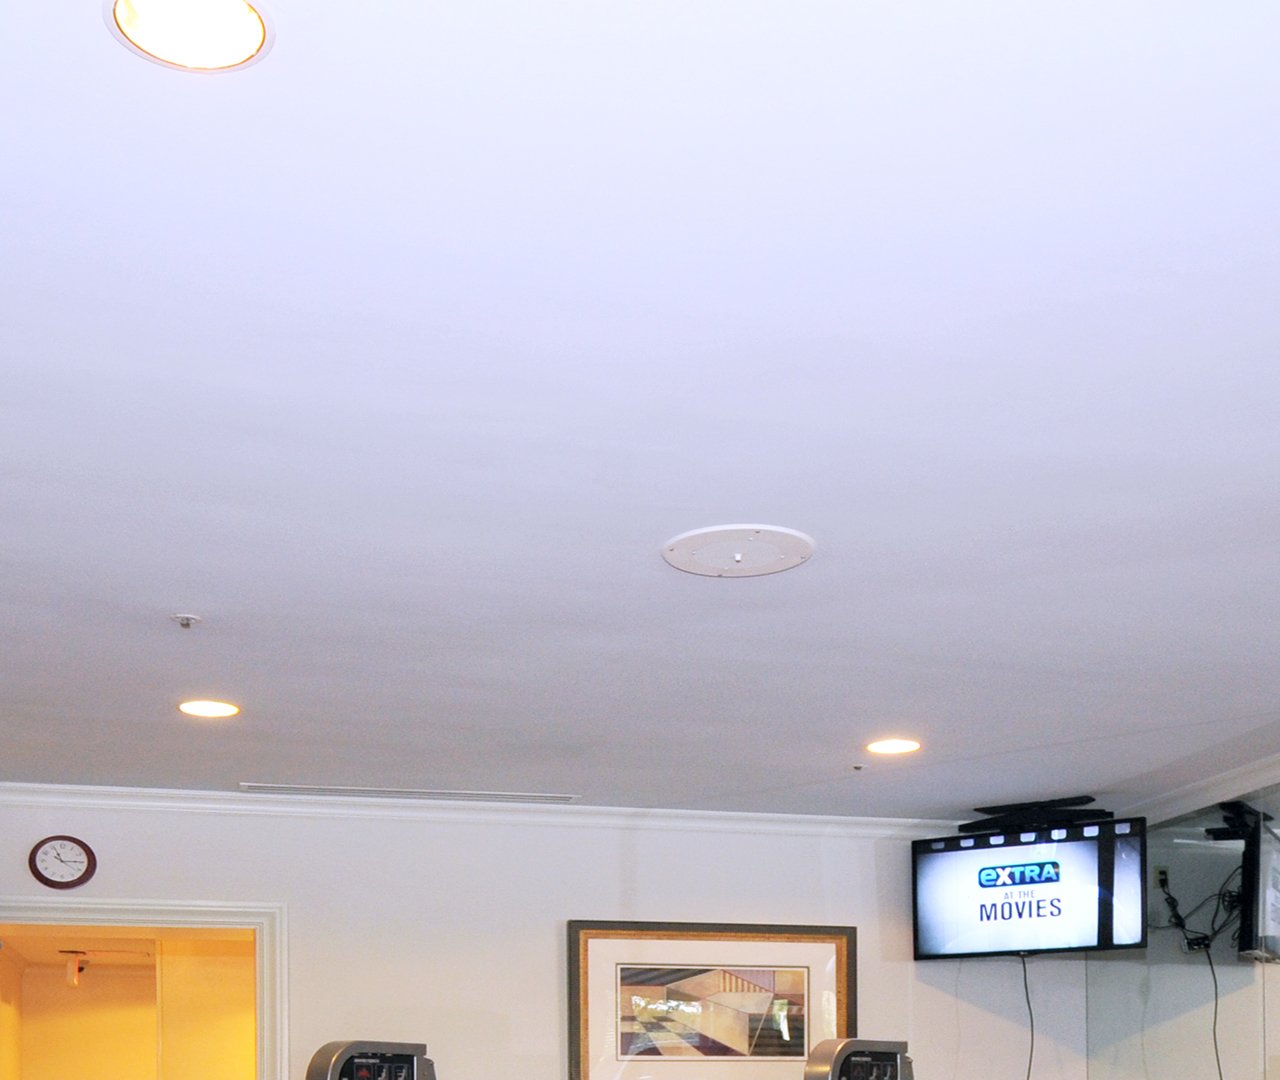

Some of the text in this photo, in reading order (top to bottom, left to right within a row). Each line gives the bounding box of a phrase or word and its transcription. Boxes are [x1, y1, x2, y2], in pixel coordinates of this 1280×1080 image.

[1004, 889, 1036, 900] AT THE
[979, 898, 1062, 922] MOVIES
